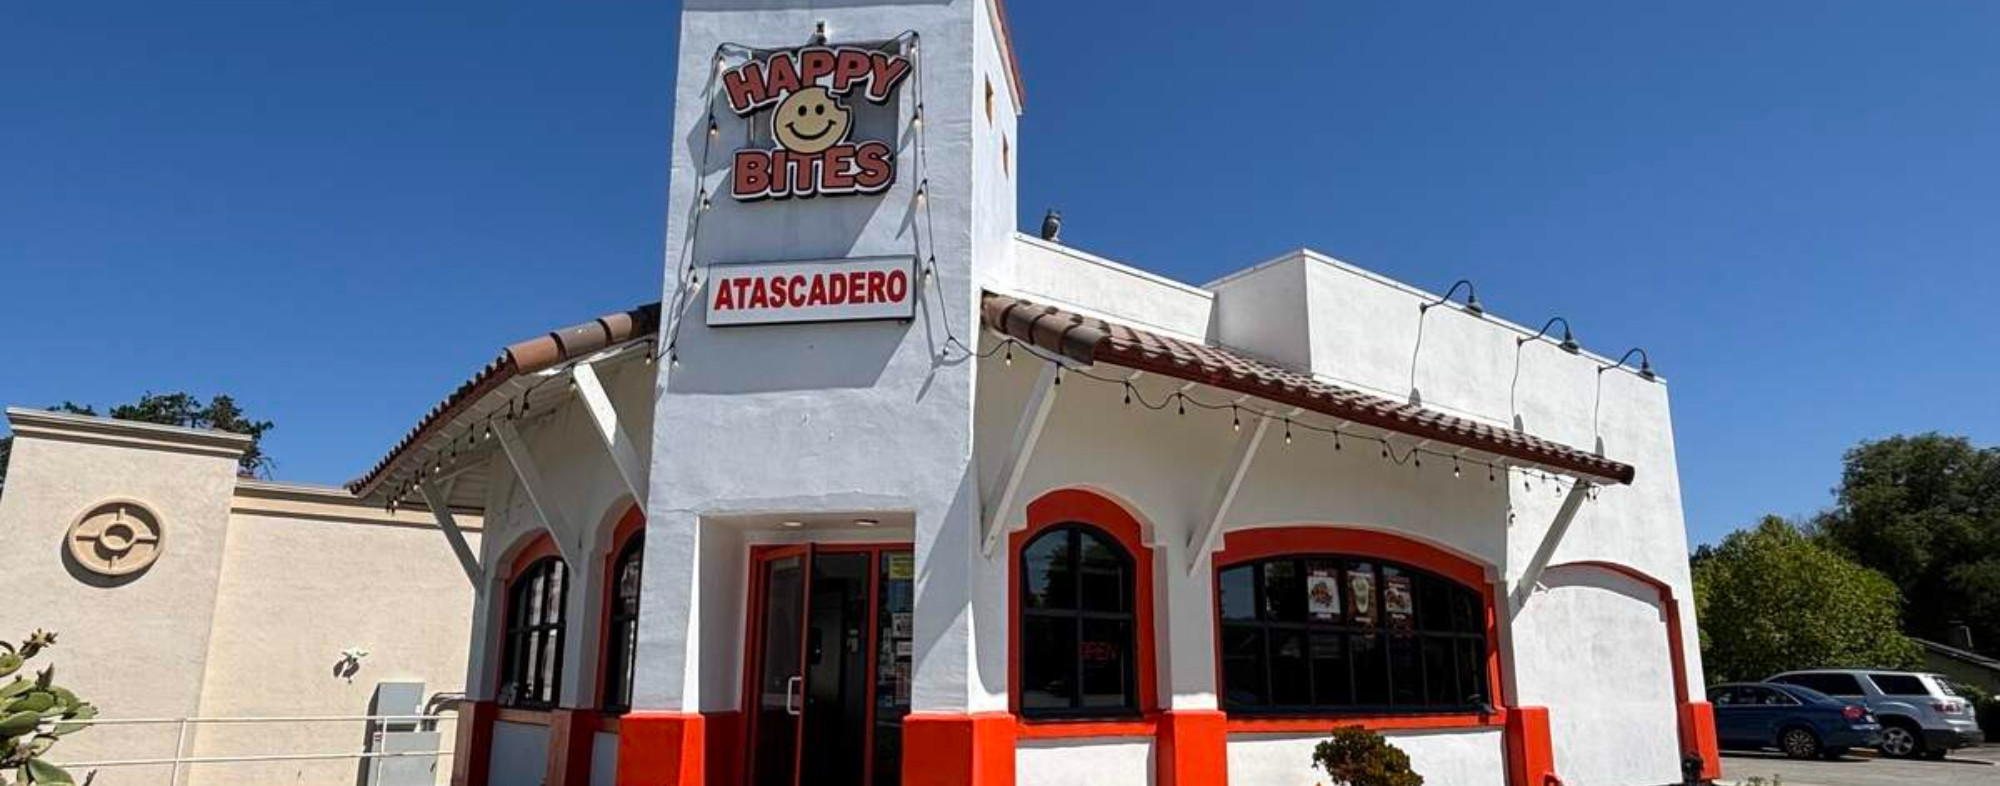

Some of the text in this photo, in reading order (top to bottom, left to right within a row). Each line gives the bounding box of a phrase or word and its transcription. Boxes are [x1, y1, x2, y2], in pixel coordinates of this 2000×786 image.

[724, 49, 910, 111] HAPPY
[733, 144, 892, 196] BITES
[714, 270, 908, 310] ATASCADERO
